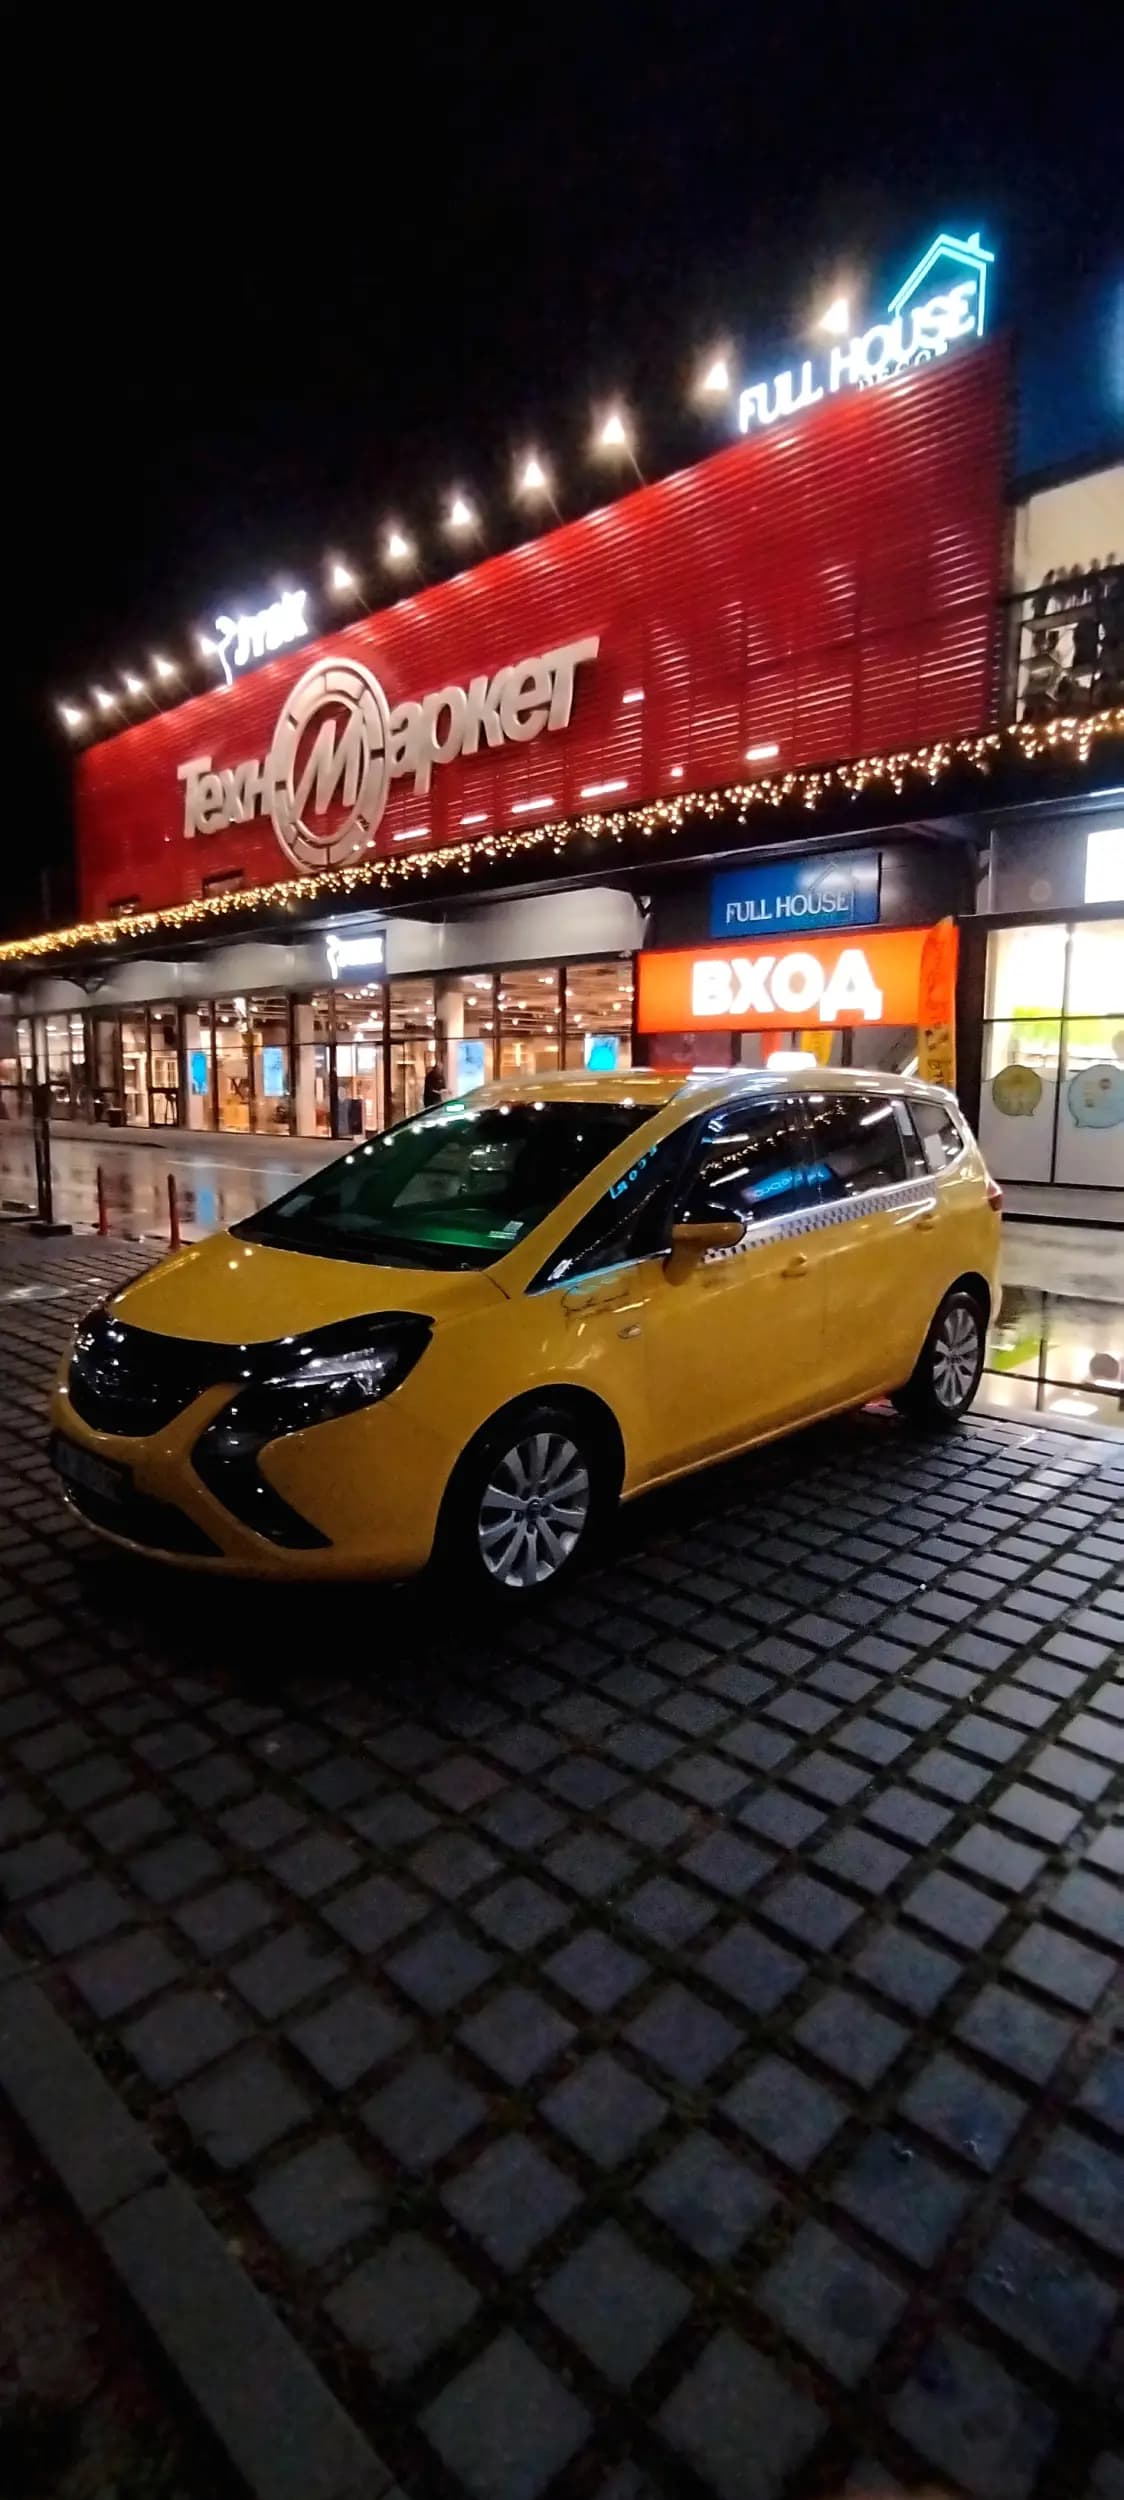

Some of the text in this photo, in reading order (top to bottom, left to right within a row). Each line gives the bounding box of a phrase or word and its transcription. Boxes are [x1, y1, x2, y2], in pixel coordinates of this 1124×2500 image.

[739, 280, 977, 433] FULL HOUSE
[726, 891, 849, 924] FULL HOUSE
[692, 949, 883, 1022] ВХОД
